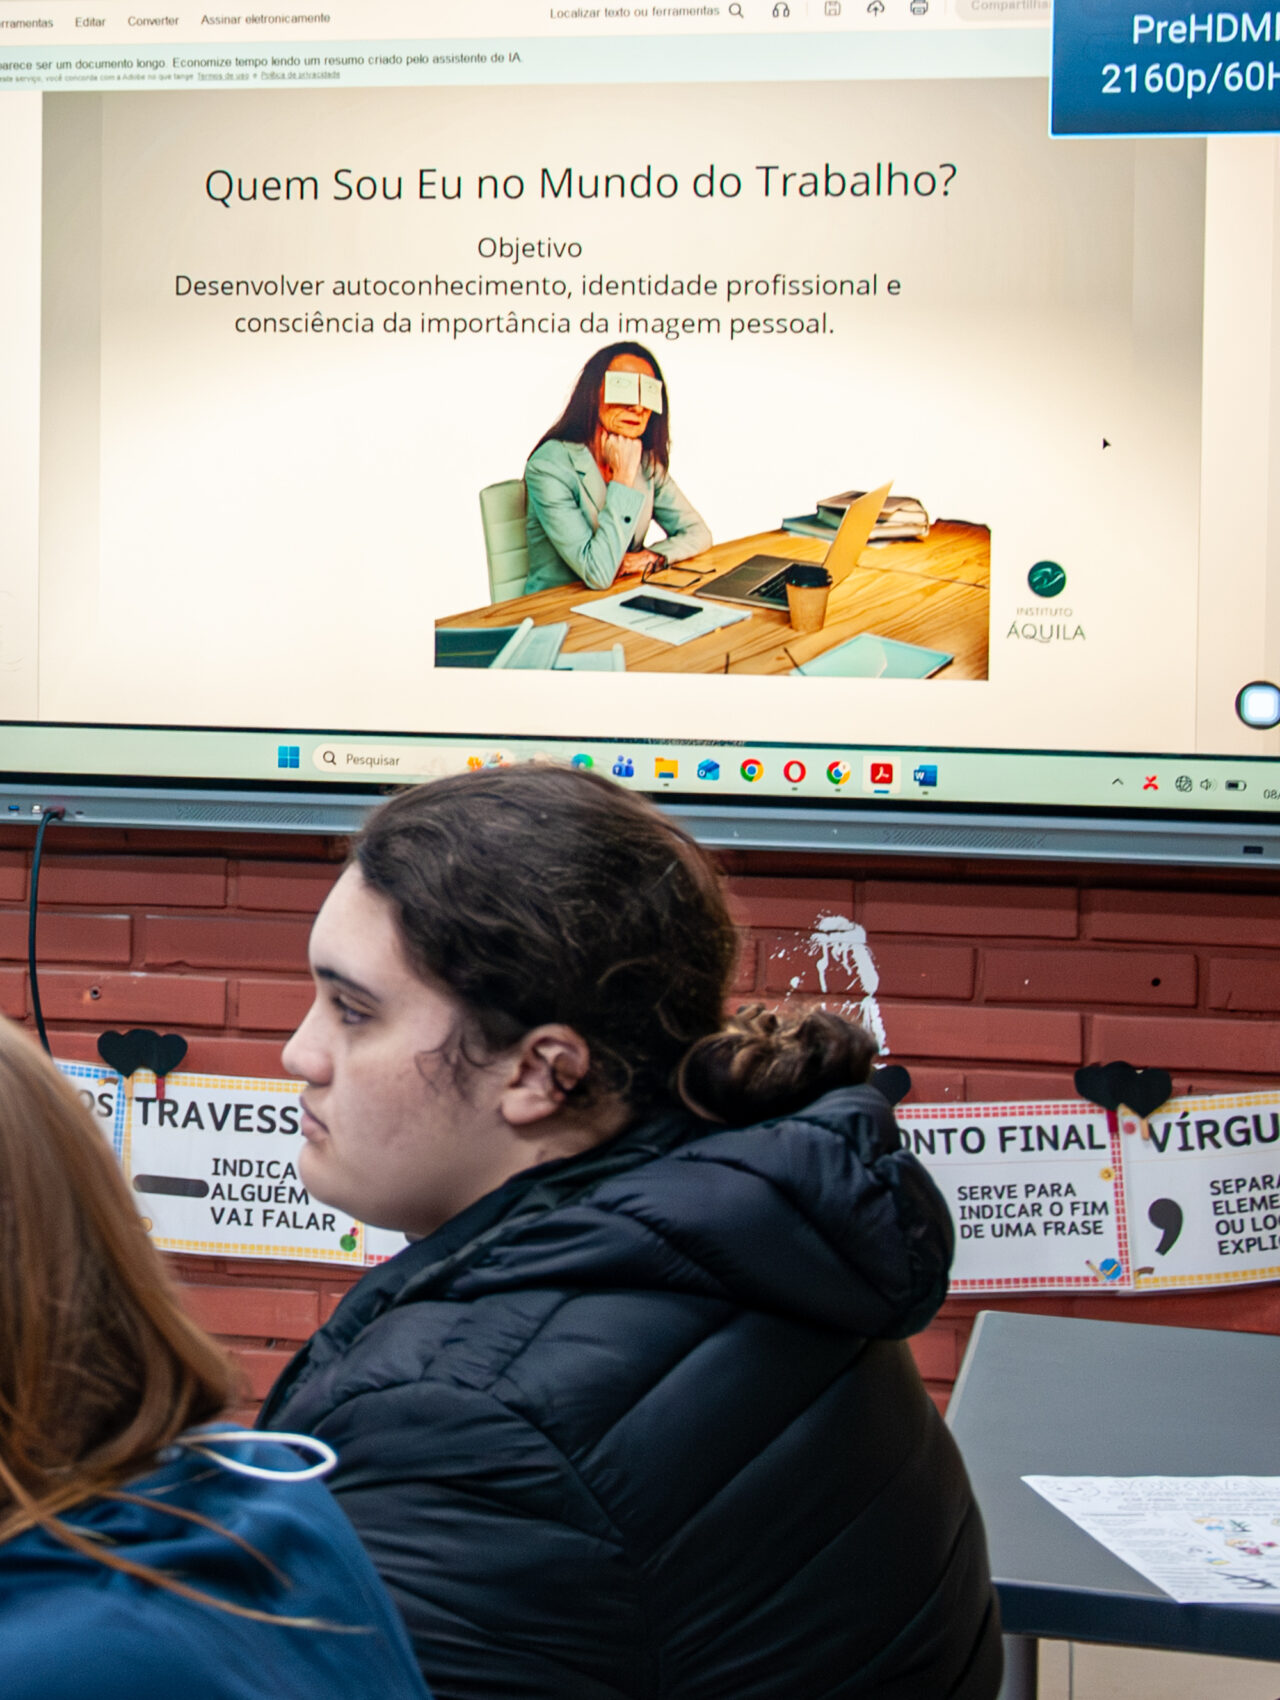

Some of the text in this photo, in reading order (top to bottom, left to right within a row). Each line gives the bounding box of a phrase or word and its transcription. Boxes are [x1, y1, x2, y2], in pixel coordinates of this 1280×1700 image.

[75, 17, 106, 27] Editar
[128, 16, 179, 26] Converter
[201, 13, 331, 25] Assinar eletronicamente
[550, 6, 719, 19] Localizar texto ou ferramentas
[36, 61, 52, 70] ser
[56, 60, 72, 70] um
[75, 58, 133, 69] documento
[172, 57, 232, 68] Economize
[236, 58, 268, 69] tempo
[272, 56, 300, 66] lendo
[304, 57, 320, 66] um
[324, 56, 364, 65] resumo
[368, 54, 402, 64] criado
[406, 54, 429, 66] pelo
[432, 53, 487, 64] assistente
[490, 53, 504, 63] de
[206, 162, 957, 208] Quem Sou Eu no Mundo do Trabalho?
[477, 237, 583, 265] Objetivo
[175, 274, 902, 302] Desenvolver autoconhecimento, identidade profissional e
[235, 311, 834, 340] consciência da importância da imagem pessoal.
[1016, 607, 1073, 617] INSTITUTO
[1006, 620, 1086, 644] ÁQUILA
[346, 753, 400, 768] Pesquisar
[998, 1124, 1107, 1153] FINAL
[1148, 1111, 1280, 1153] VÍRGU
[212, 1158, 298, 1180] INDICA
[210, 1181, 310, 1206] ALGUÉM
[957, 1183, 1077, 1201] SERVE PARA
[1209, 1174, 1280, 1196] SEPAR
[210, 1206, 336, 1232] VAI FALAR
[960, 1201, 1109, 1220] INDICAR O FIM
[960, 1220, 1104, 1239] DE UMA FRASE
[1215, 1214, 1280, 1236] OU LO
[1218, 1234, 1280, 1256] EXPLI
